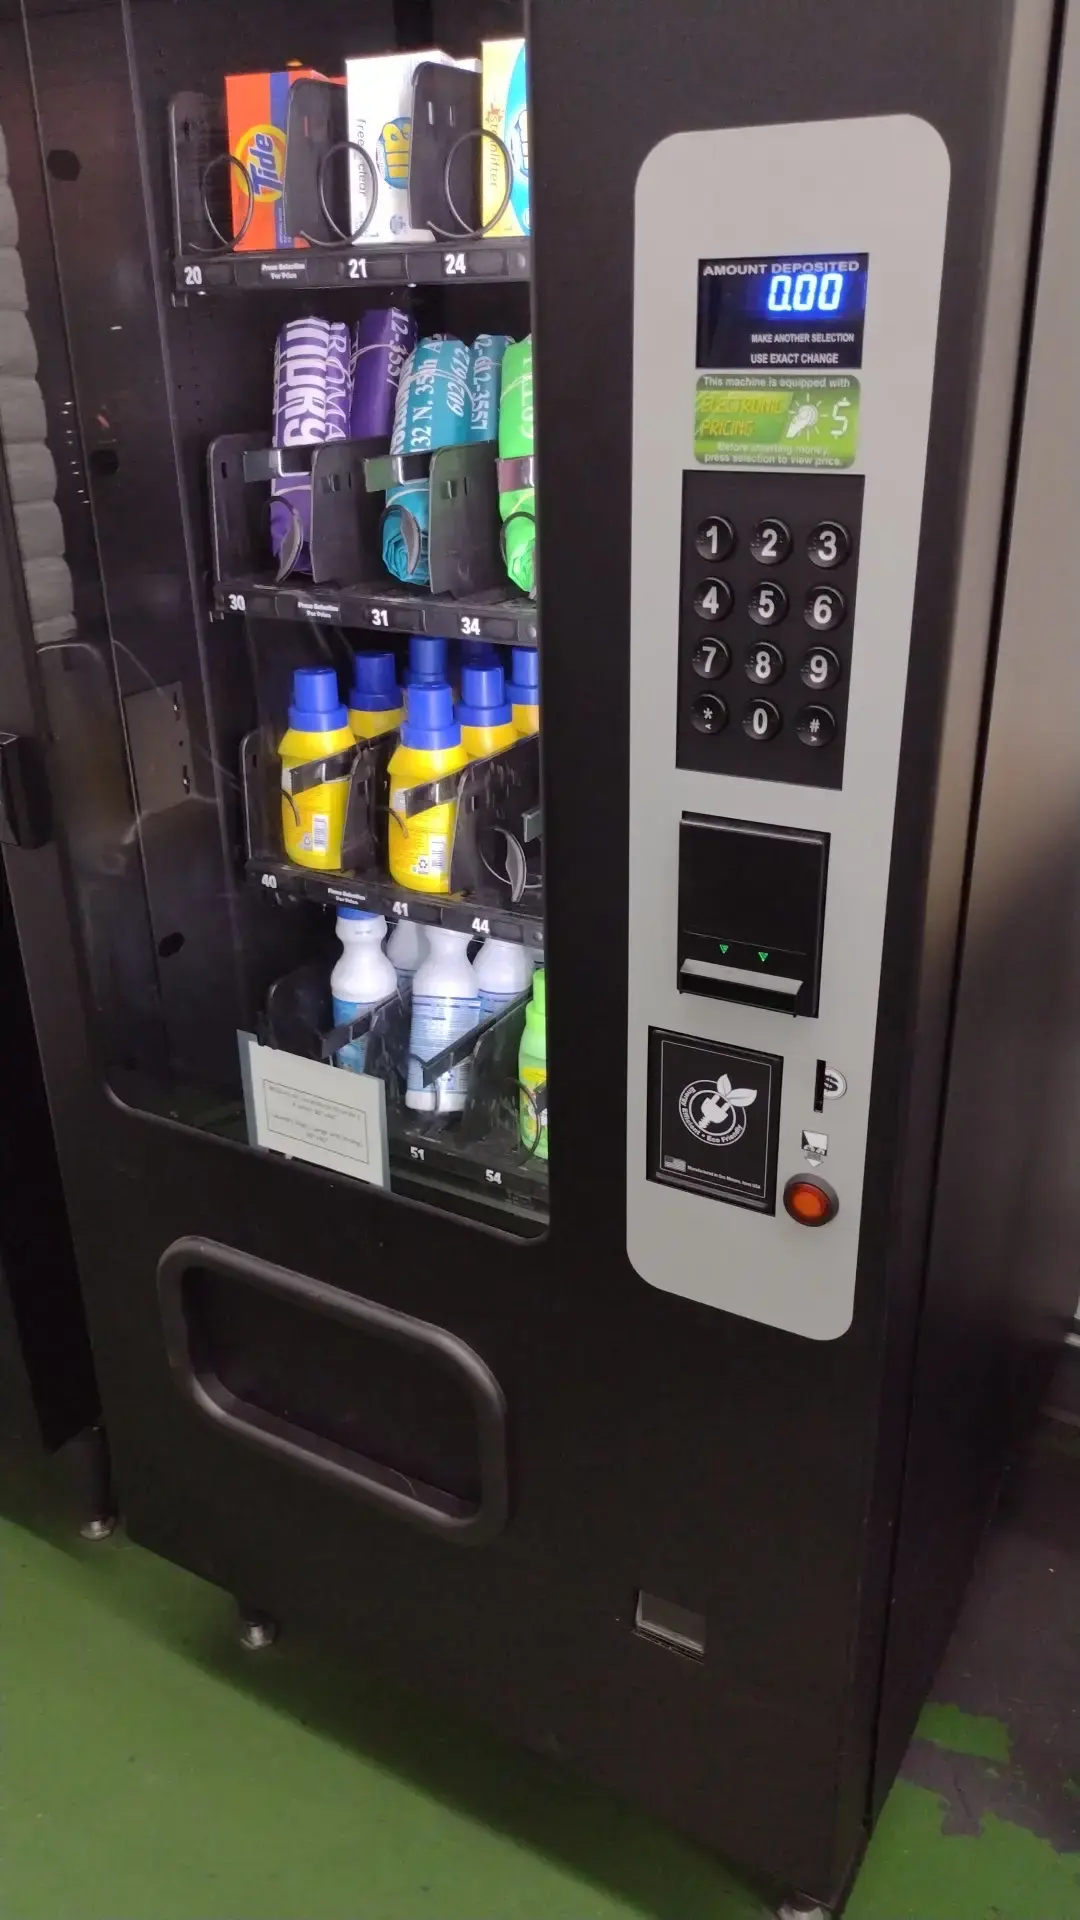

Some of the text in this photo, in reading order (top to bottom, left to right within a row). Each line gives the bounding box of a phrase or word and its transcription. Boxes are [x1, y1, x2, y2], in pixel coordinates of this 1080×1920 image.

[248, 132, 283, 196] Tide
[356, 118, 368, 197] free clear
[349, 259, 366, 279] 21
[445, 254, 466, 275] 24
[703, 261, 860, 276] AMOUNT DEPOSITED
[184, 266, 202, 286] 20
[768, 273, 843, 311] 0.00
[751, 333, 855, 343] MAKE ANOTHER SELECTION
[751, 353, 839, 364] USE EXACT CHANGE
[704, 377, 850, 389] This machine is equipped with
[700, 420, 755, 436] PRICING
[718, 442, 749, 452] Before
[704, 453, 843, 466] press selection to view price.
[706, 526, 717, 554] 1
[761, 528, 778, 557] 2
[818, 530, 837, 561] 3
[229, 594, 246, 611] 30
[702, 586, 719, 614] 4
[758, 590, 775, 618] 5
[813, 594, 833, 624] 6
[371, 609, 389, 627] 31
[461, 617, 480, 636] 34
[702, 646, 717, 673] 7
[755, 651, 771, 679] 8
[810, 654, 827, 683] 9
[753, 708, 768, 734] 0
[261, 874, 277, 889] 40
[392, 901, 408, 916] 41
[472, 918, 490, 934] 44
[682, 1108, 701, 1135] Efficient
[706, 1135, 721, 1143] Eco
[721, 1124, 743, 1143] Friendly
[410, 1146, 425, 1160] 51
[486, 1169, 502, 1184] 54
